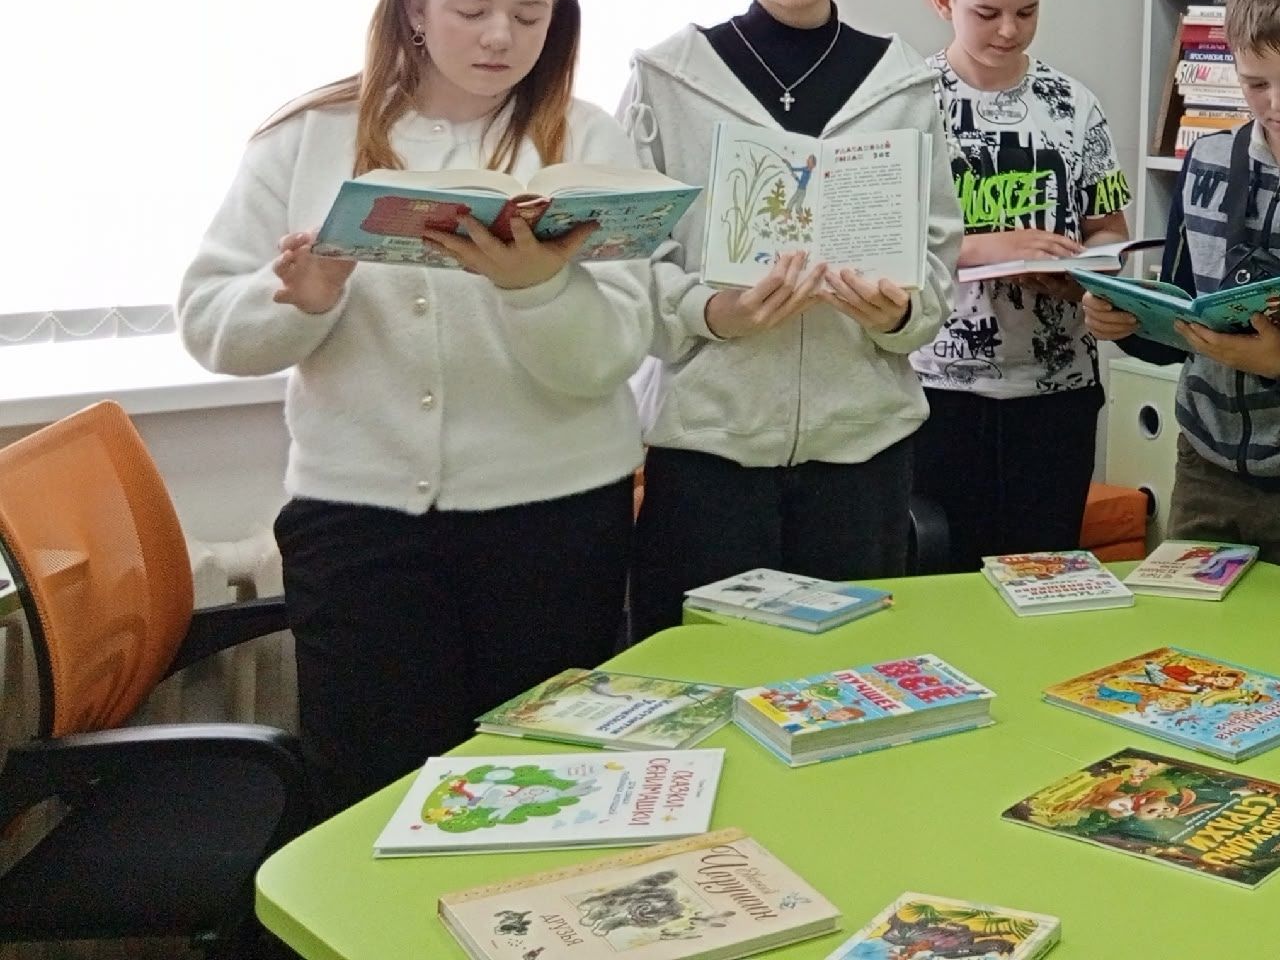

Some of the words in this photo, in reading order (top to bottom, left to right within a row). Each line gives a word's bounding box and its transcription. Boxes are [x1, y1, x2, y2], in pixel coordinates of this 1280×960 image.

[834, 672, 902, 711] ЛУЧШЕЕ
[1215, 724, 1257, 740] Гена
[663, 770, 694, 812] СКАЗКИ-
[1184, 796, 1277, 852] СТРАХИ
[697, 844, 778, 921] Чарушин
[539, 913, 585, 947] ДРУЗЬЯ
